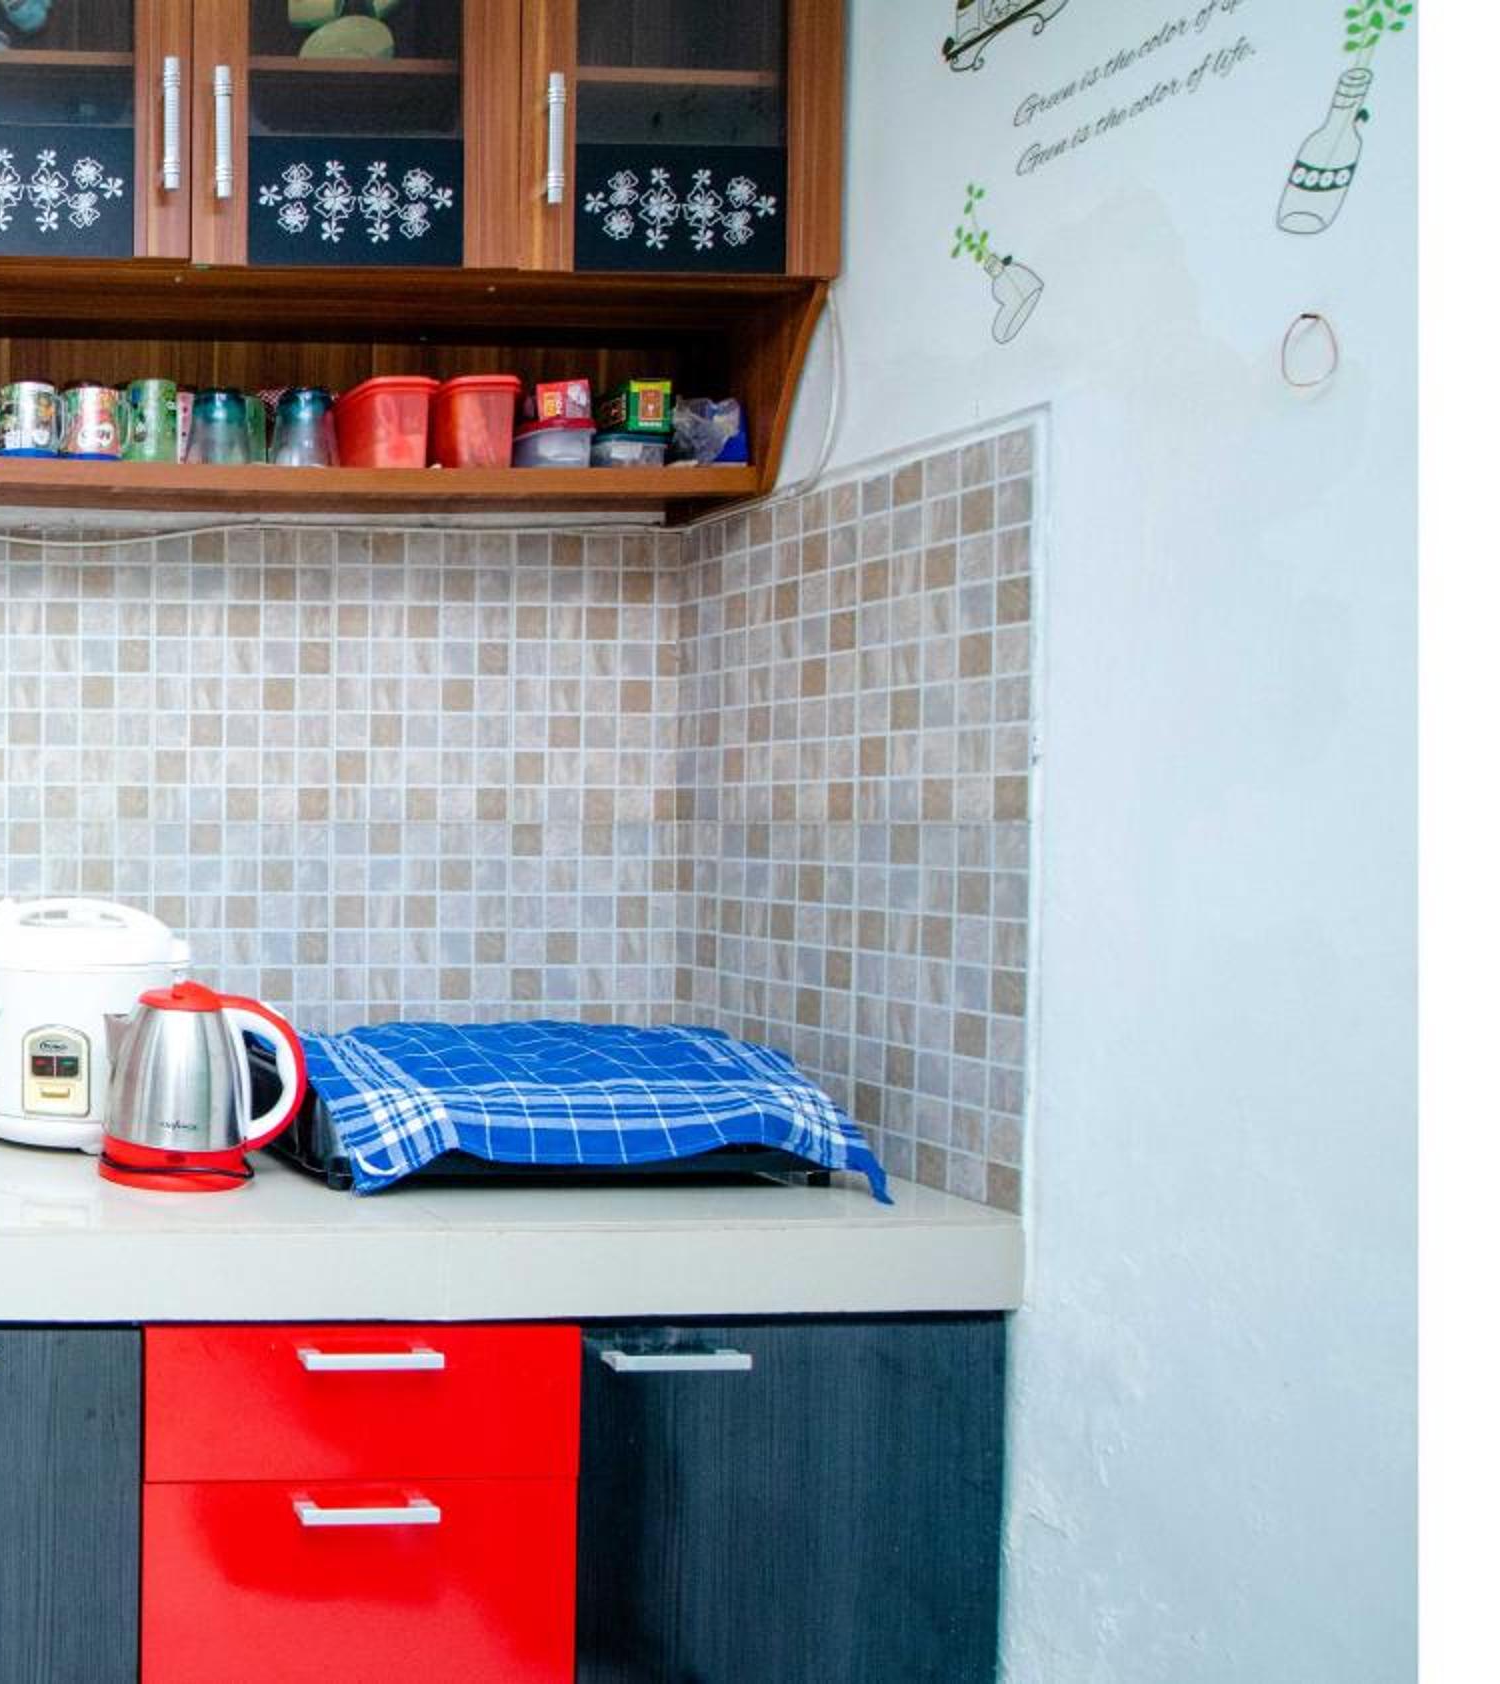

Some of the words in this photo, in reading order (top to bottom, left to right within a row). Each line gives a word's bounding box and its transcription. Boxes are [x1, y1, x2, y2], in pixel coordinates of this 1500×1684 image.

[1079, 66, 1100, 91] is
[1103, 48, 1134, 78] the
[1137, 19, 1188, 58] color
[1070, 124, 1092, 148] is
[1095, 106, 1127, 136] the
[1128, 78, 1181, 118] color
[1185, 53, 1212, 94] of
